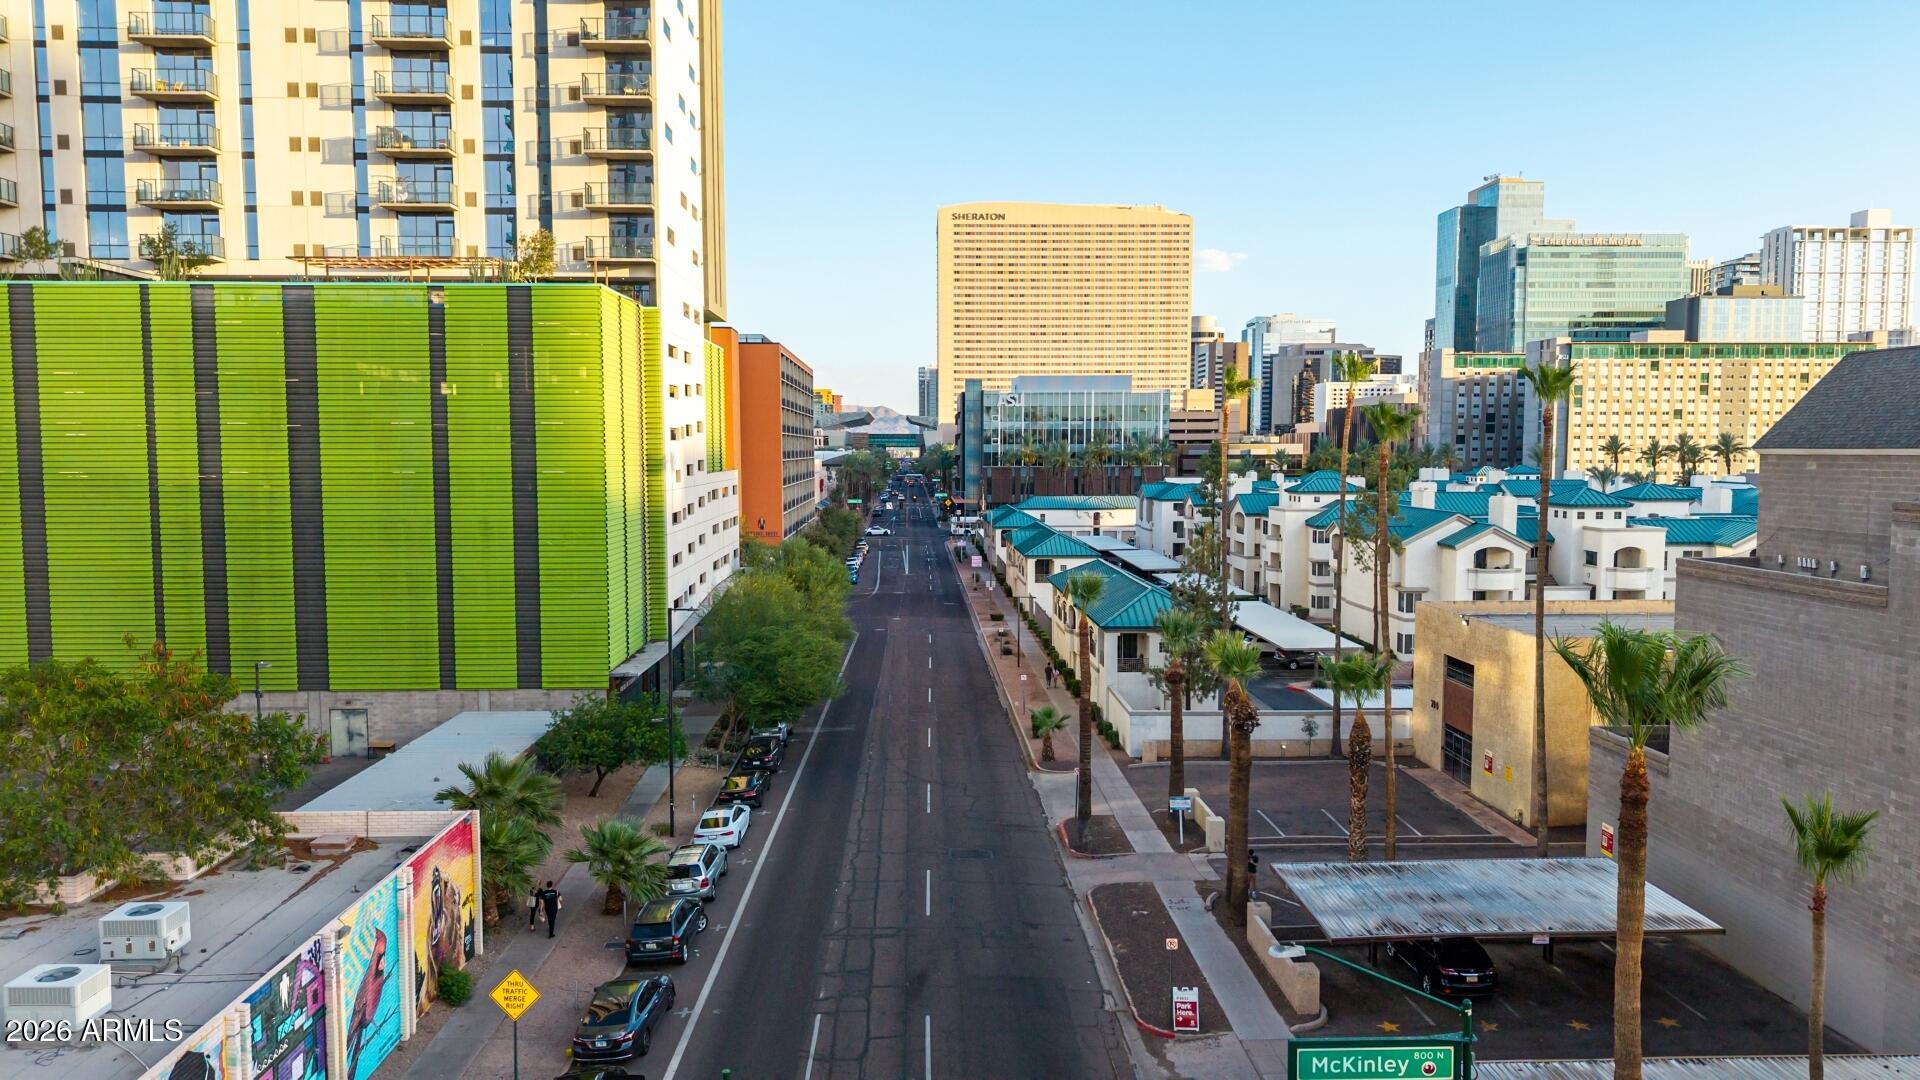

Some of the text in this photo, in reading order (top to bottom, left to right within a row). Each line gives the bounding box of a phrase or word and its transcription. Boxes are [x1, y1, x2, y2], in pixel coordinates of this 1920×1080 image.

[951, 212, 1006, 220] SHERATON
[997, 393, 1024, 407] ASU
[1176, 1002, 1192, 1010] Park
[1414, 1051, 1444, 1060] 800 N
[1311, 1056, 1410, 1077] McKinley
